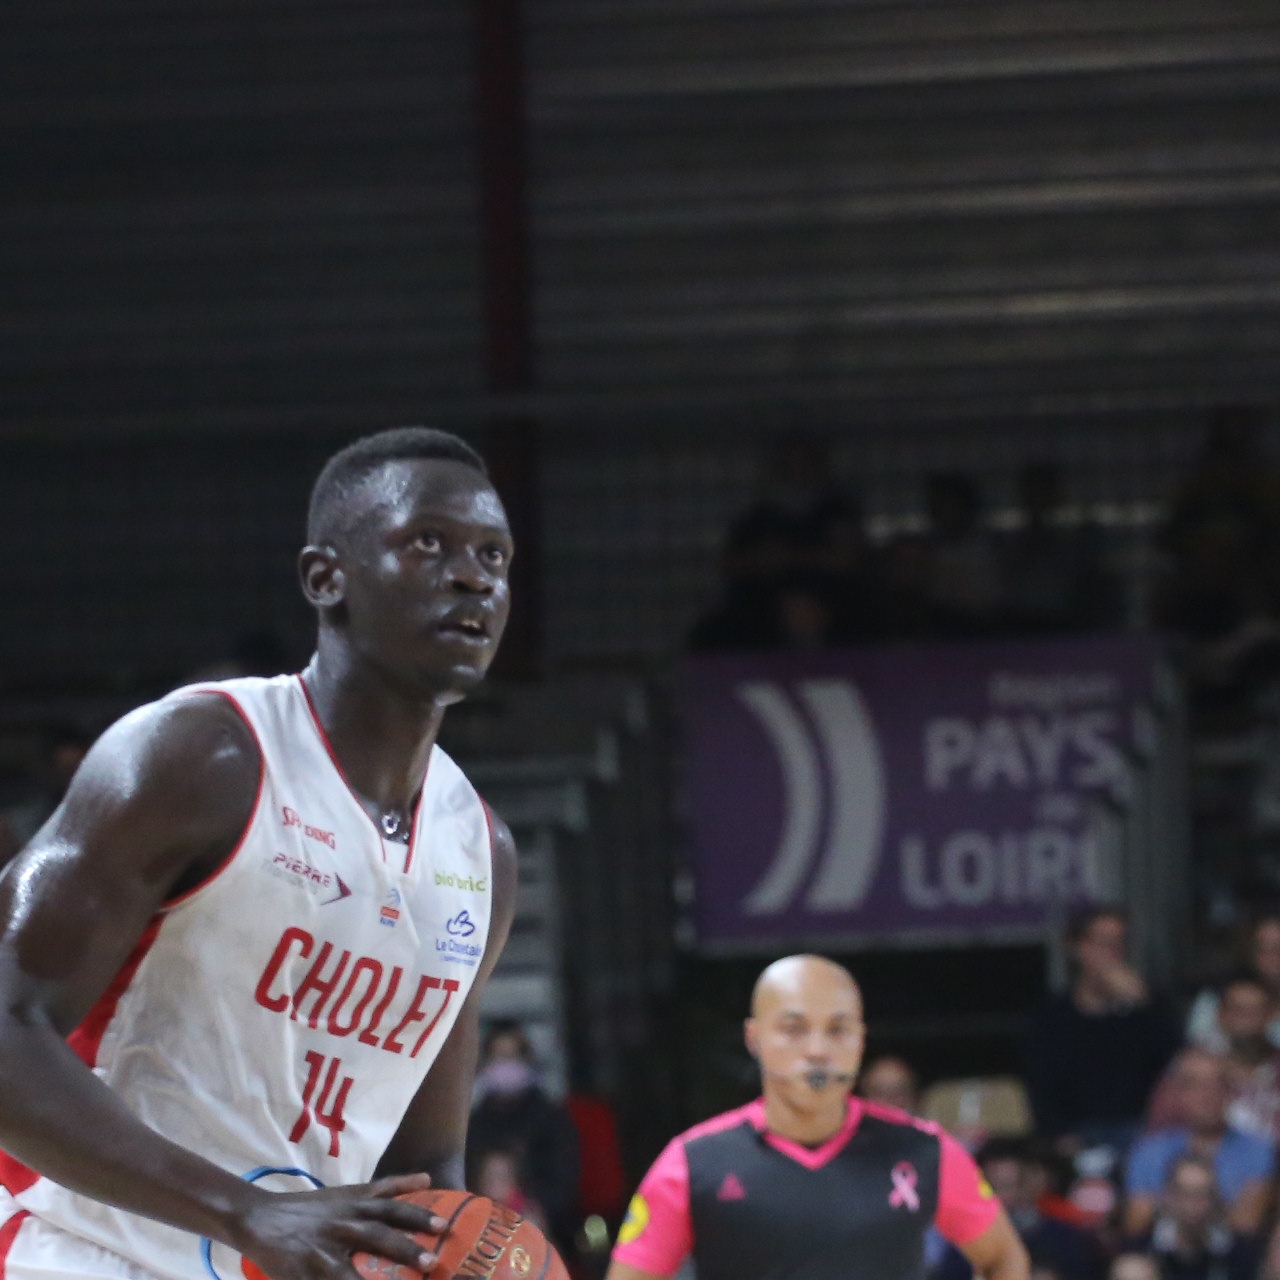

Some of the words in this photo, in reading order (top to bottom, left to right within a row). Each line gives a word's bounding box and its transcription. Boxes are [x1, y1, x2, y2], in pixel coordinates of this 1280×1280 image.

[924, 713, 1132, 794] PAYS
[254, 927, 460, 1058] CHOLET
[288, 1050, 354, 1158] 14
